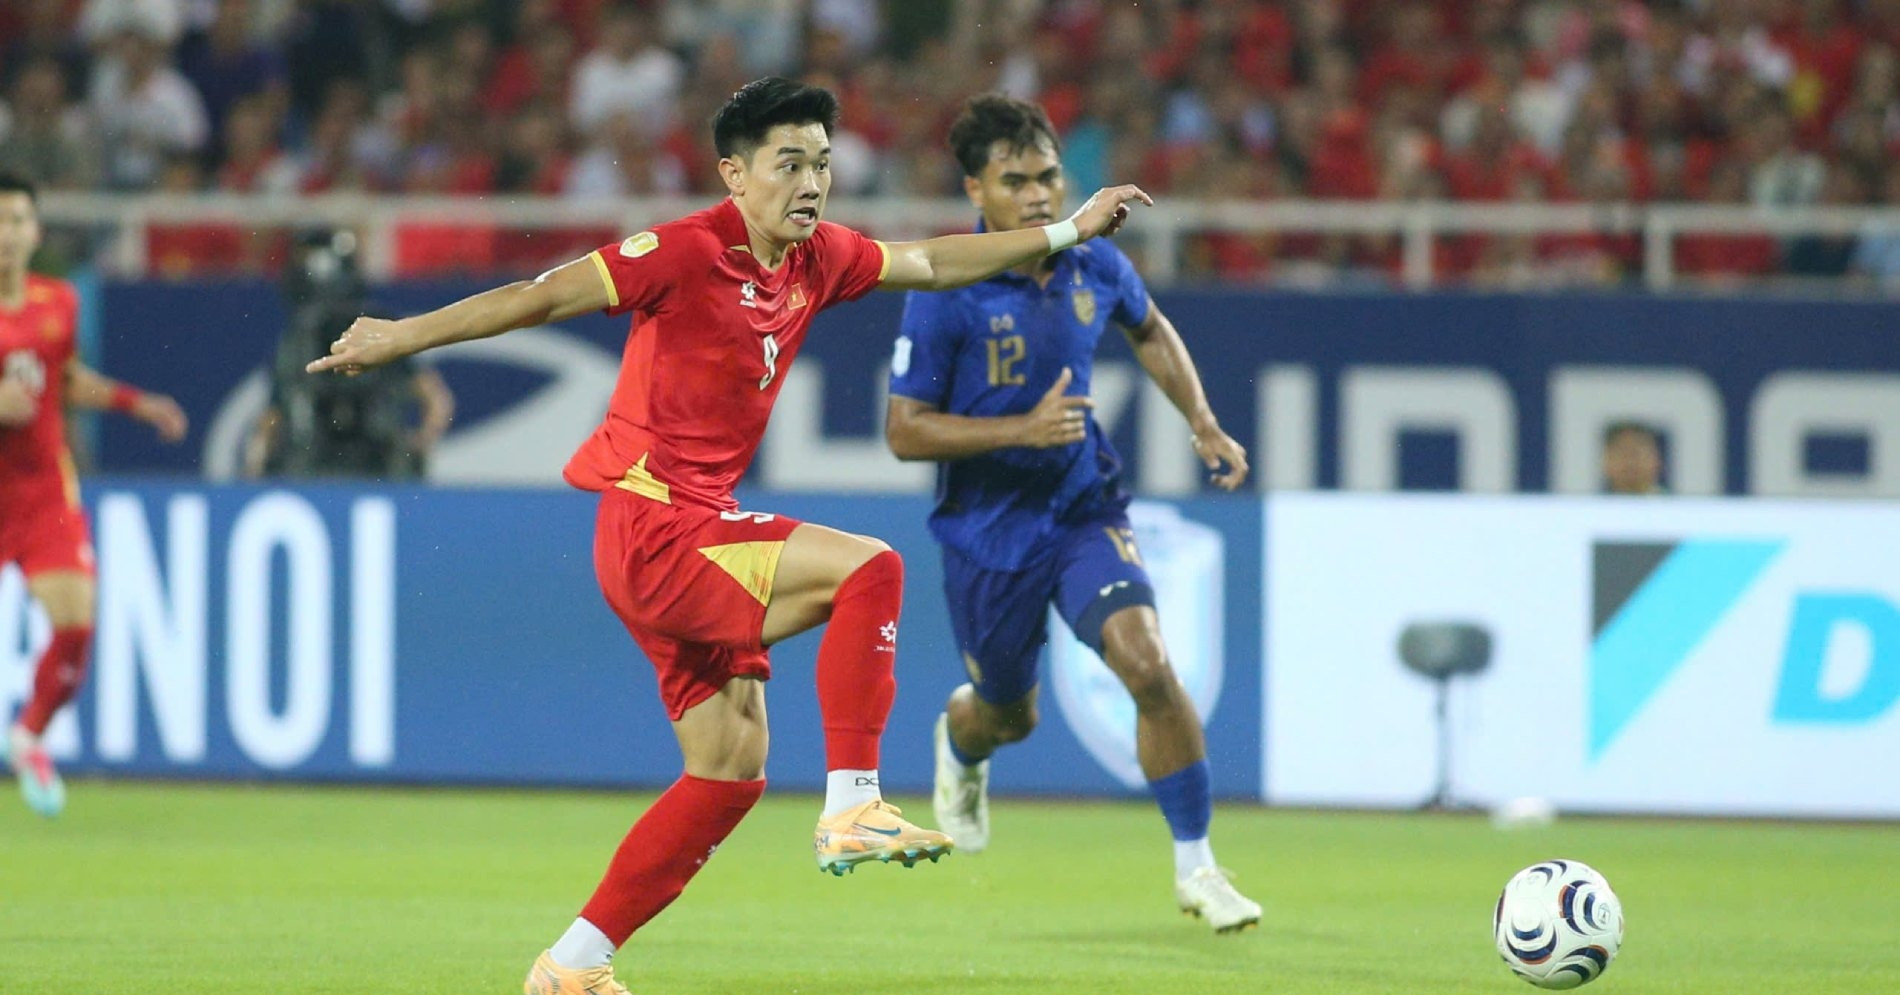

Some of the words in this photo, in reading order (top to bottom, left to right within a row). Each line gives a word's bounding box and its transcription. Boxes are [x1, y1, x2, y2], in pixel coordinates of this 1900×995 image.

[759, 334, 779, 391] 9
[986, 335, 1025, 386] 12
[1771, 592, 1900, 726] D
